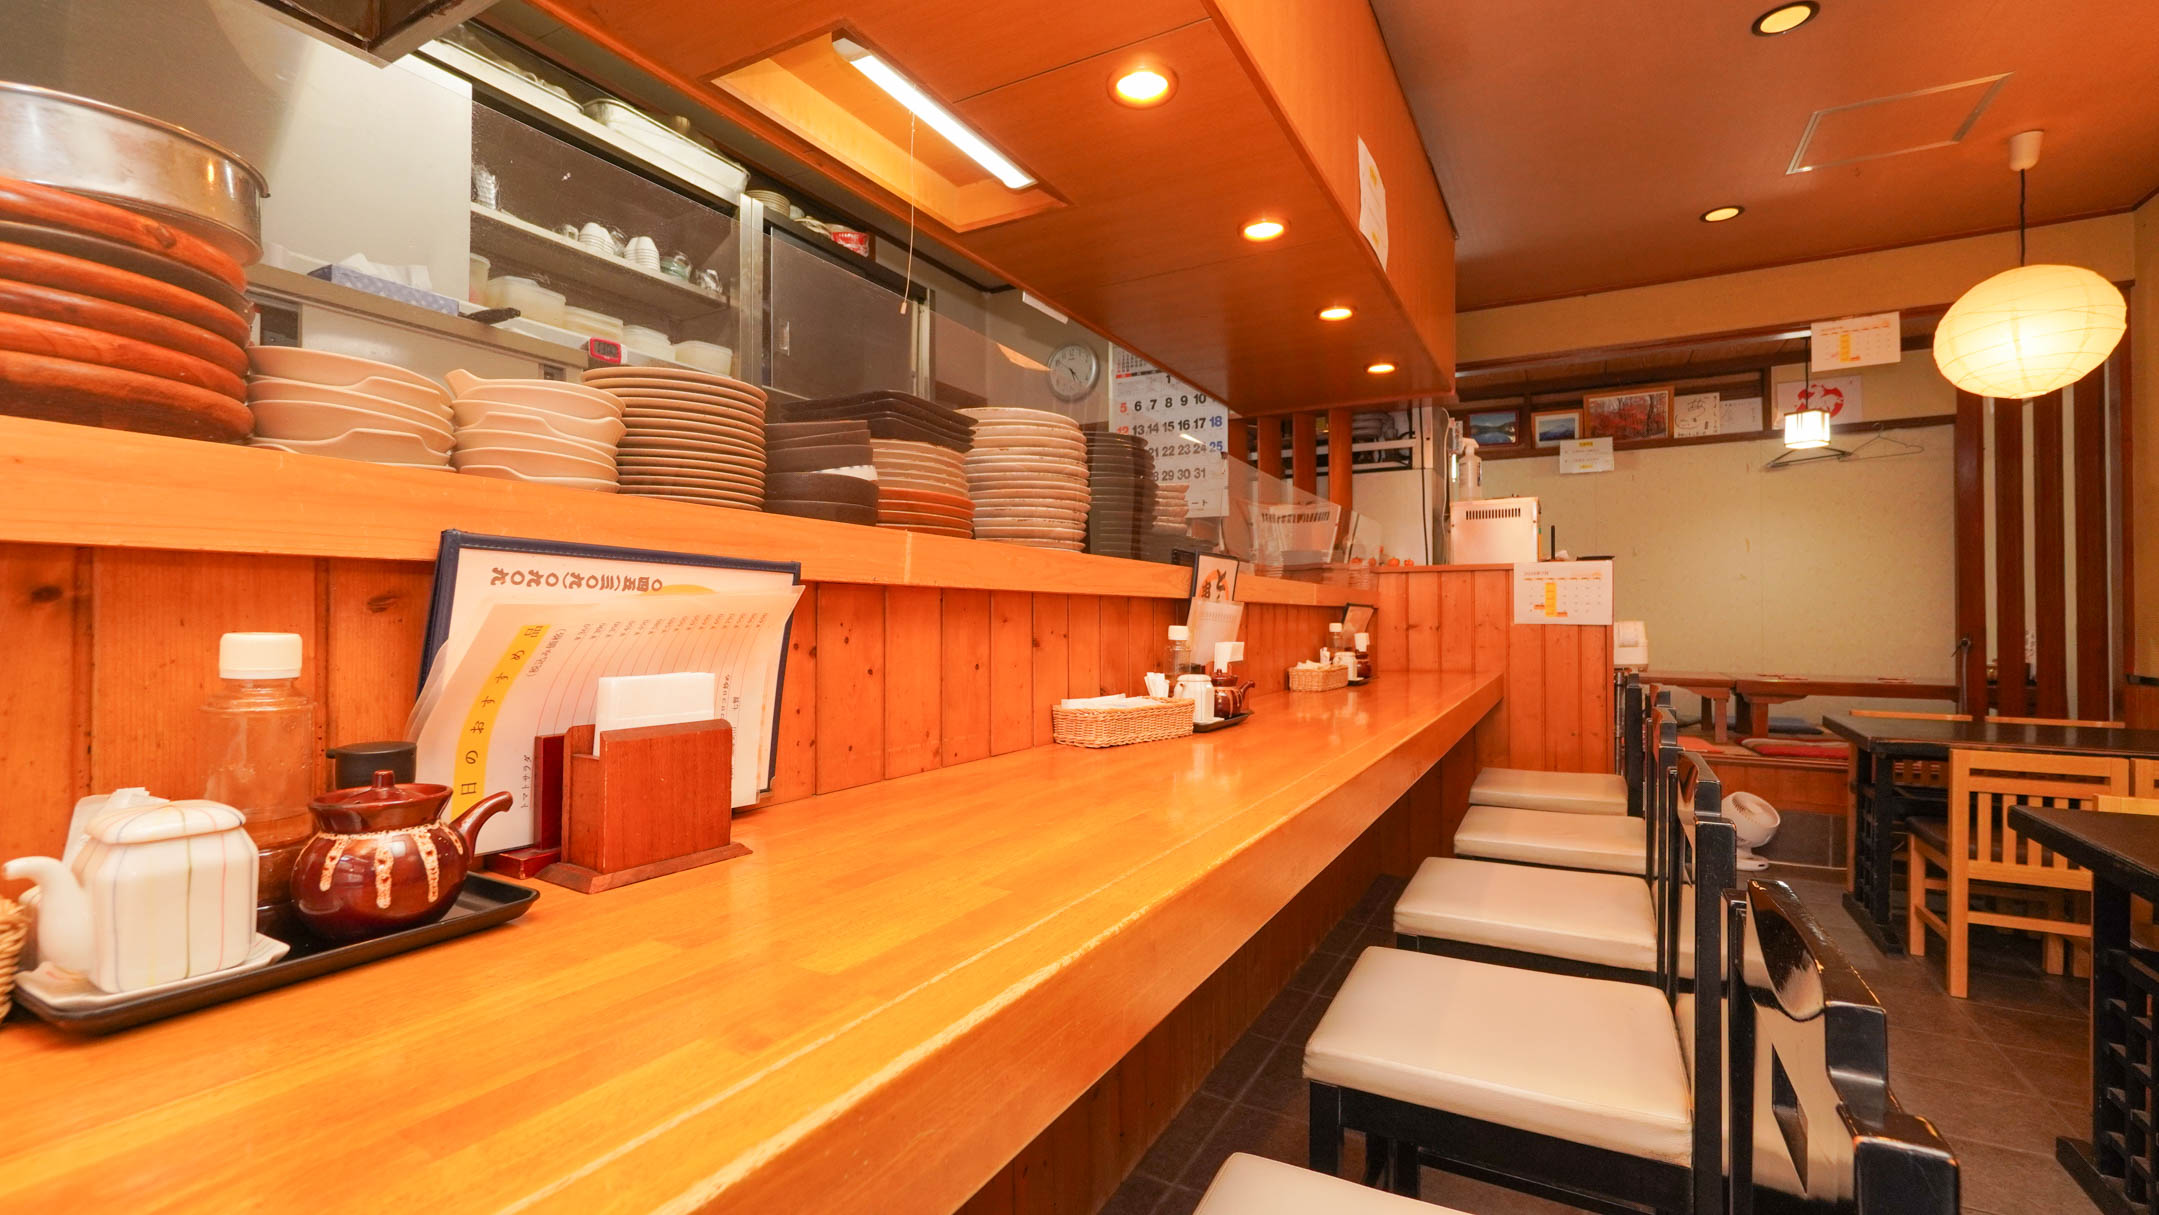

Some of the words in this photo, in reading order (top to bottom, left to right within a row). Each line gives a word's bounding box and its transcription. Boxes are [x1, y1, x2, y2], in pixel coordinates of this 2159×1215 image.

[1166, 374, 1170, 384] 1
[1119, 402, 1128, 413] 5
[1134, 400, 1142, 412] 6
[1150, 399, 1157, 410] 7
[1165, 397, 1172, 408] 8
[1180, 395, 1188, 406] 9
[1193, 393, 1207, 404] 10
[1132, 424, 1144, 436] 13
[1147, 423, 1159, 434] 14
[1162, 421, 1175, 432] 15
[1178, 420, 1190, 430] 16
[1193, 418, 1206, 429] 17
[1209, 416, 1222, 427] 18
[1162, 446, 1175, 457] 22
[1178, 444, 1191, 455] 23
[1193, 442, 1207, 453] 24
[1209, 441, 1223, 452] 25
[1162, 470, 1175, 481] 29
[1177, 468, 1190, 479] 30
[1194, 467, 1206, 478] 31
[521, 754, 531, 808] トマトサラダ
